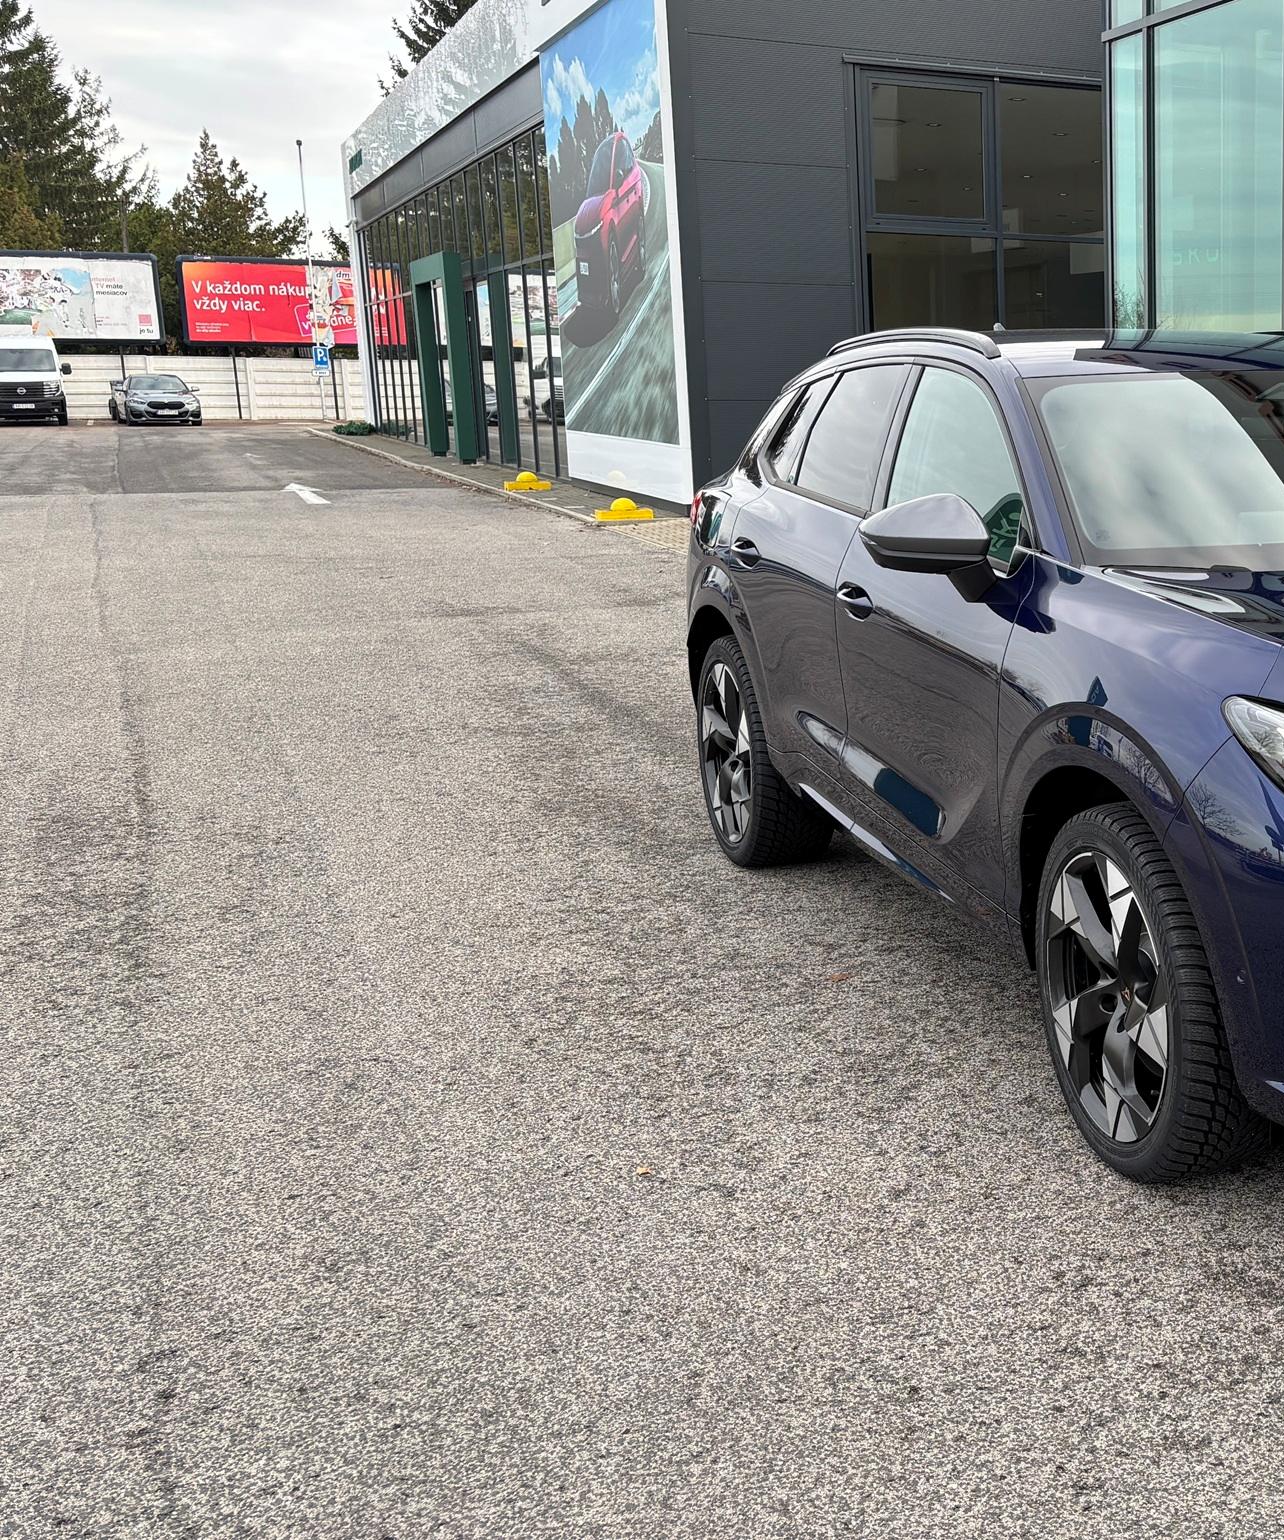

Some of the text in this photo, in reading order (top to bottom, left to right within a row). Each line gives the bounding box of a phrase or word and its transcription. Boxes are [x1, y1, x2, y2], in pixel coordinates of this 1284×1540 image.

[192, 280, 202, 293] V
[207, 280, 264, 295] každom
[193, 296, 265, 313] vždy viac.
[317, 348, 324, 361] P
